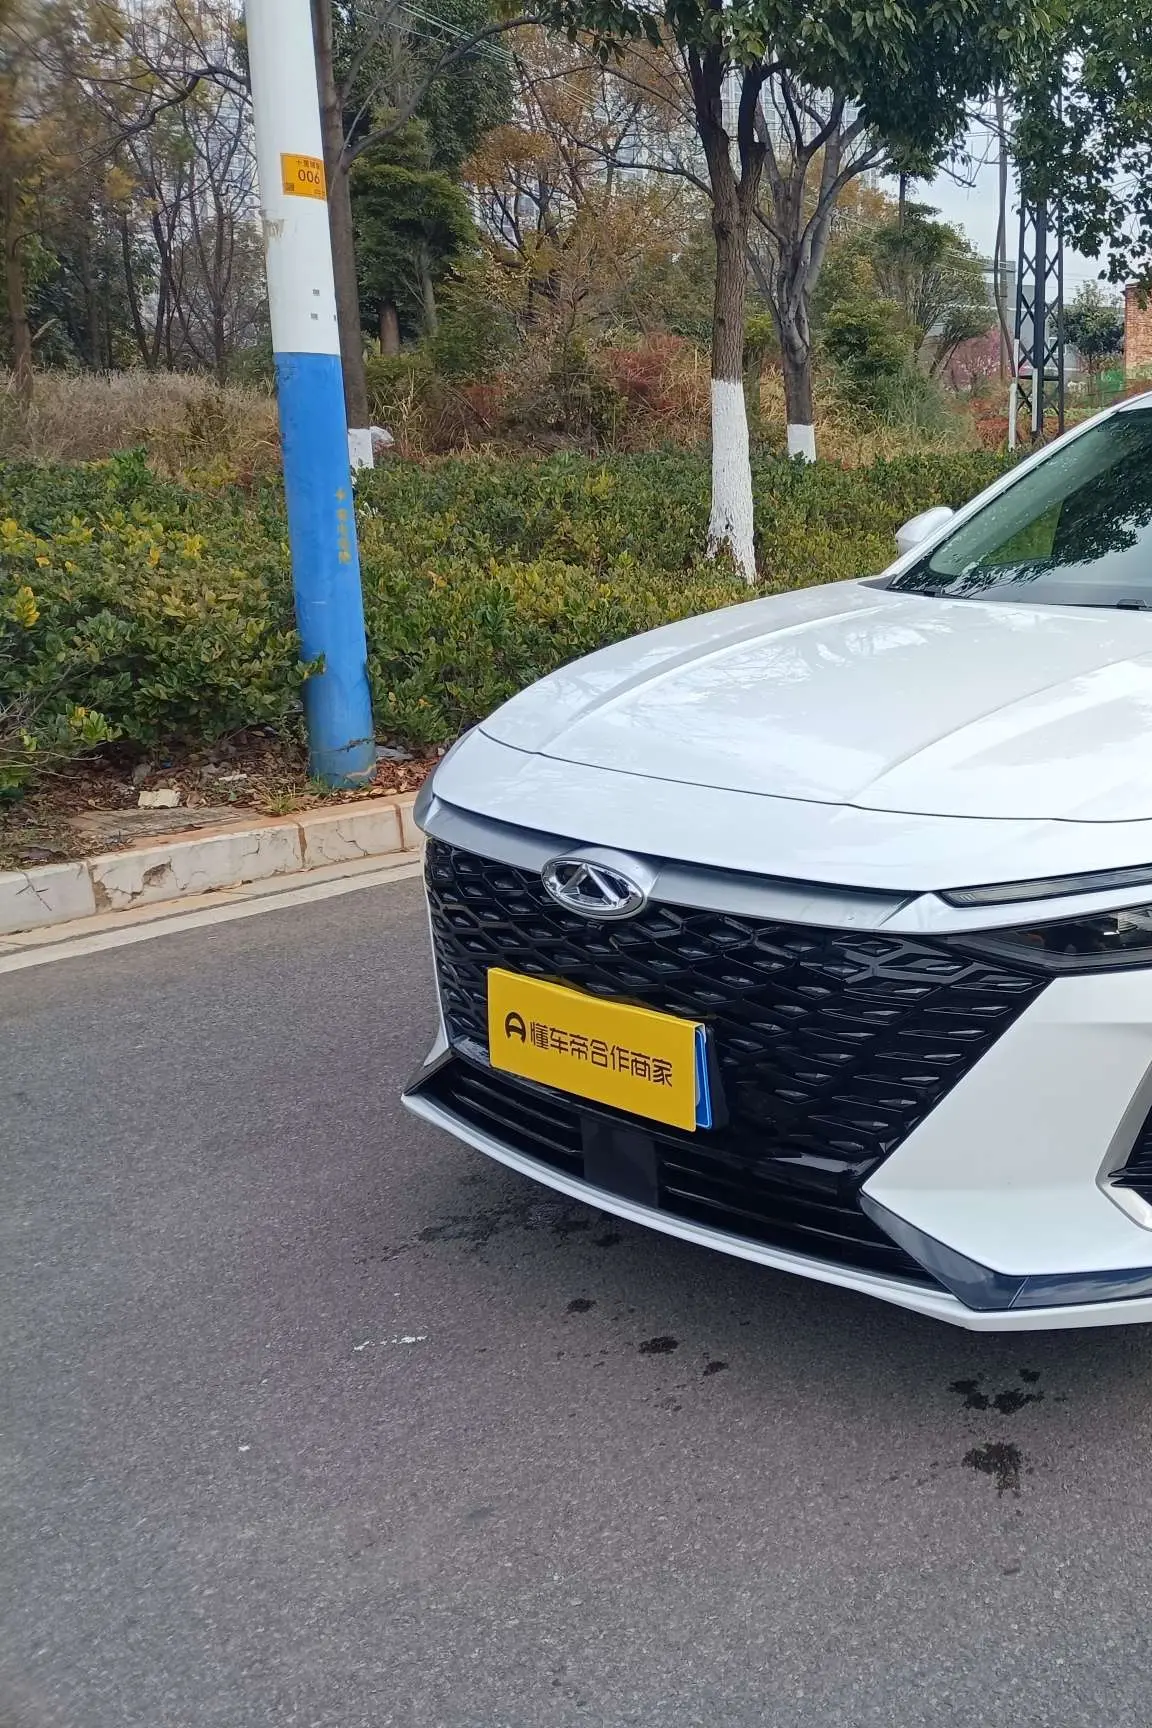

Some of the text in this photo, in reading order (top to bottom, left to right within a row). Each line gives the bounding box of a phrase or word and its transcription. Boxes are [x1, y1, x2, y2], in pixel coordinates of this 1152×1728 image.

[298, 169, 320, 184] 006
[530, 1021, 673, 1088] 懂车帝合作商家
